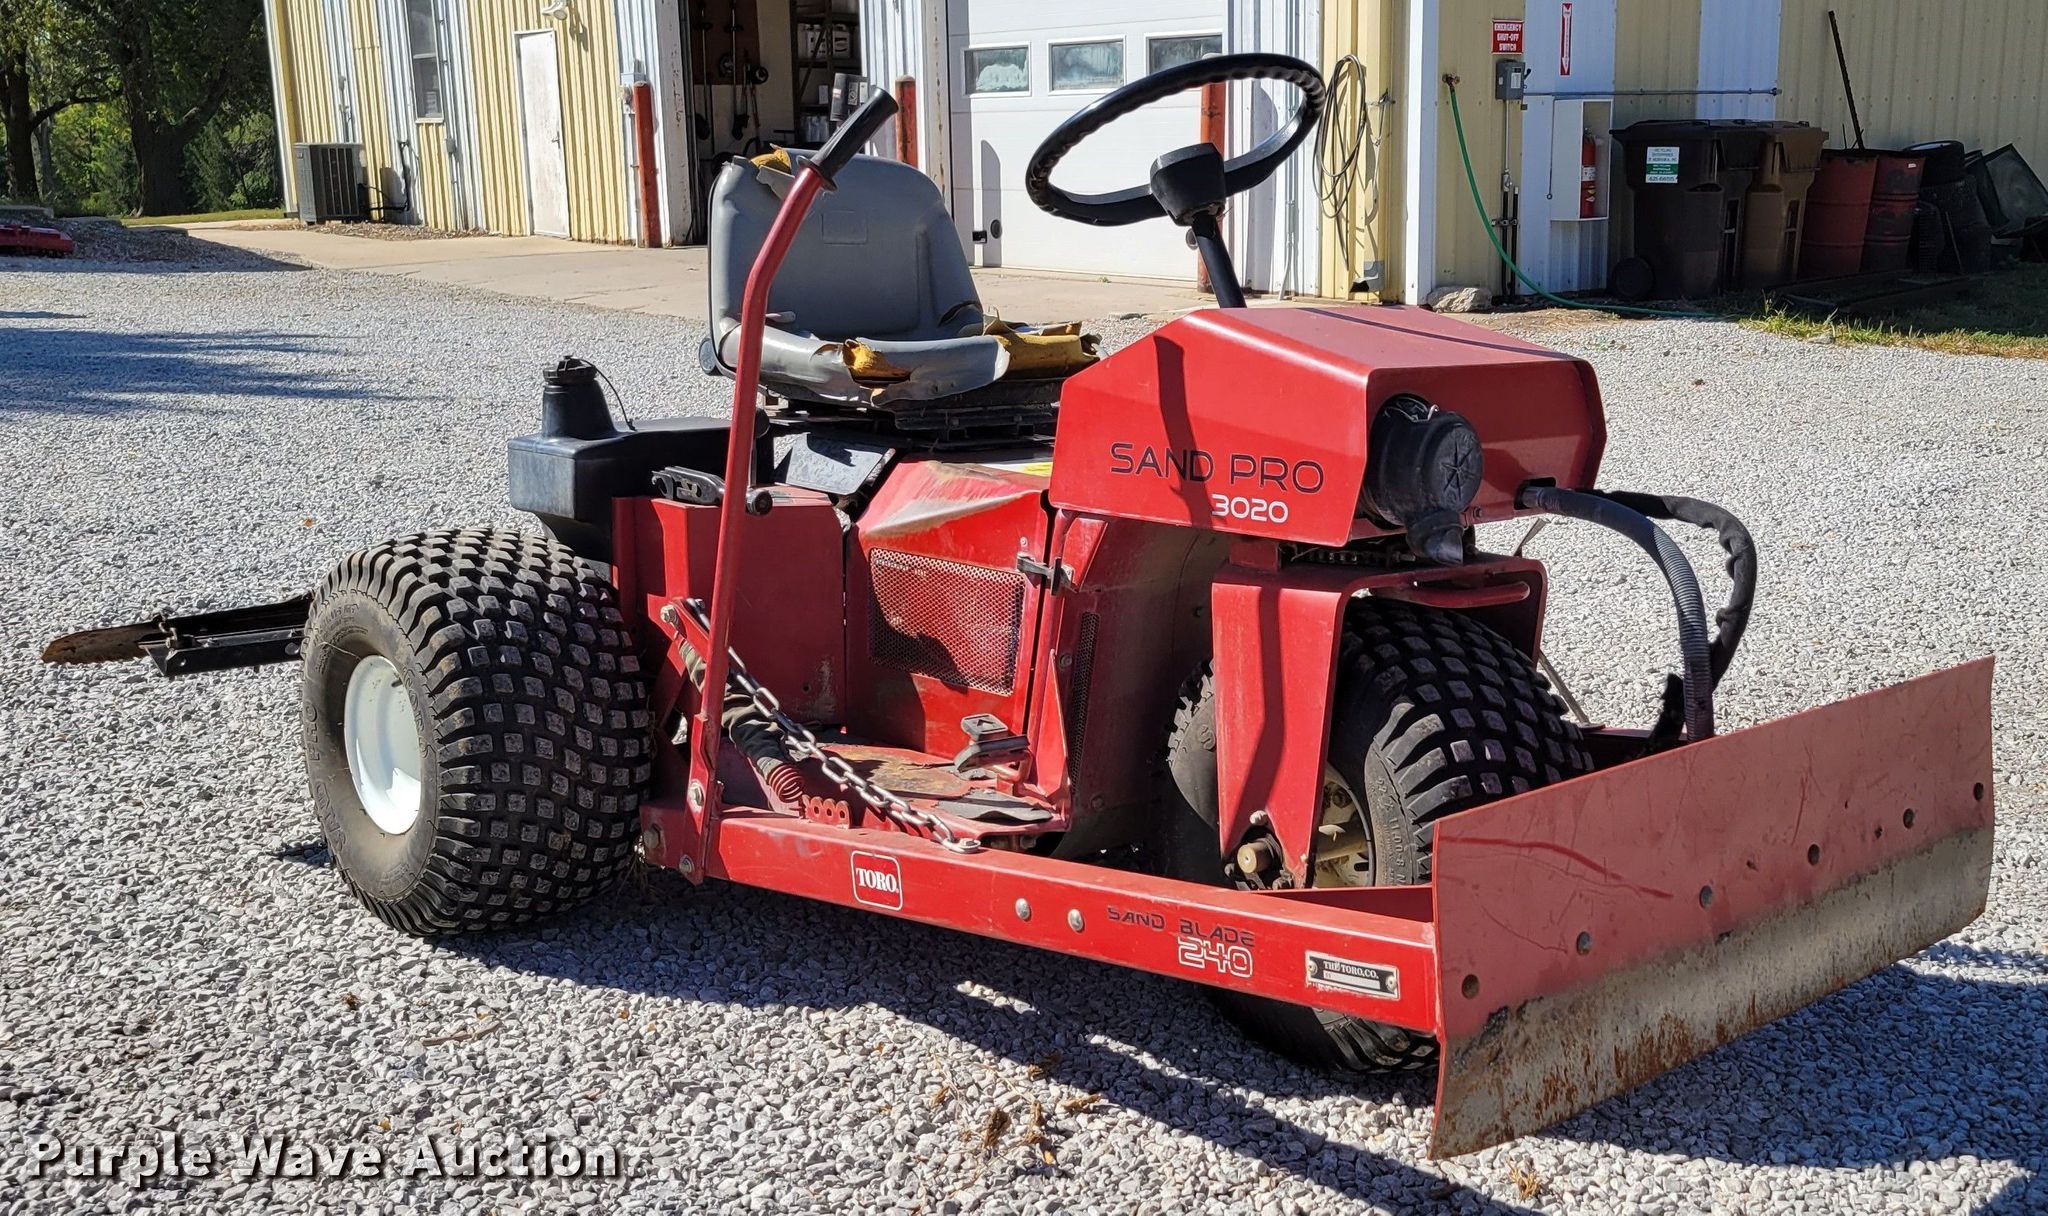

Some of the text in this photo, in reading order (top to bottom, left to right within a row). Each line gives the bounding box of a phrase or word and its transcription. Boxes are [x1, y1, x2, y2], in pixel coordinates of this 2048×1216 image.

[1110, 442, 1324, 494] SAND PRO
[1212, 493, 1289, 523] 3020
[1108, 907, 1254, 947] SAND BLADE
[1178, 936, 1253, 978] 240
